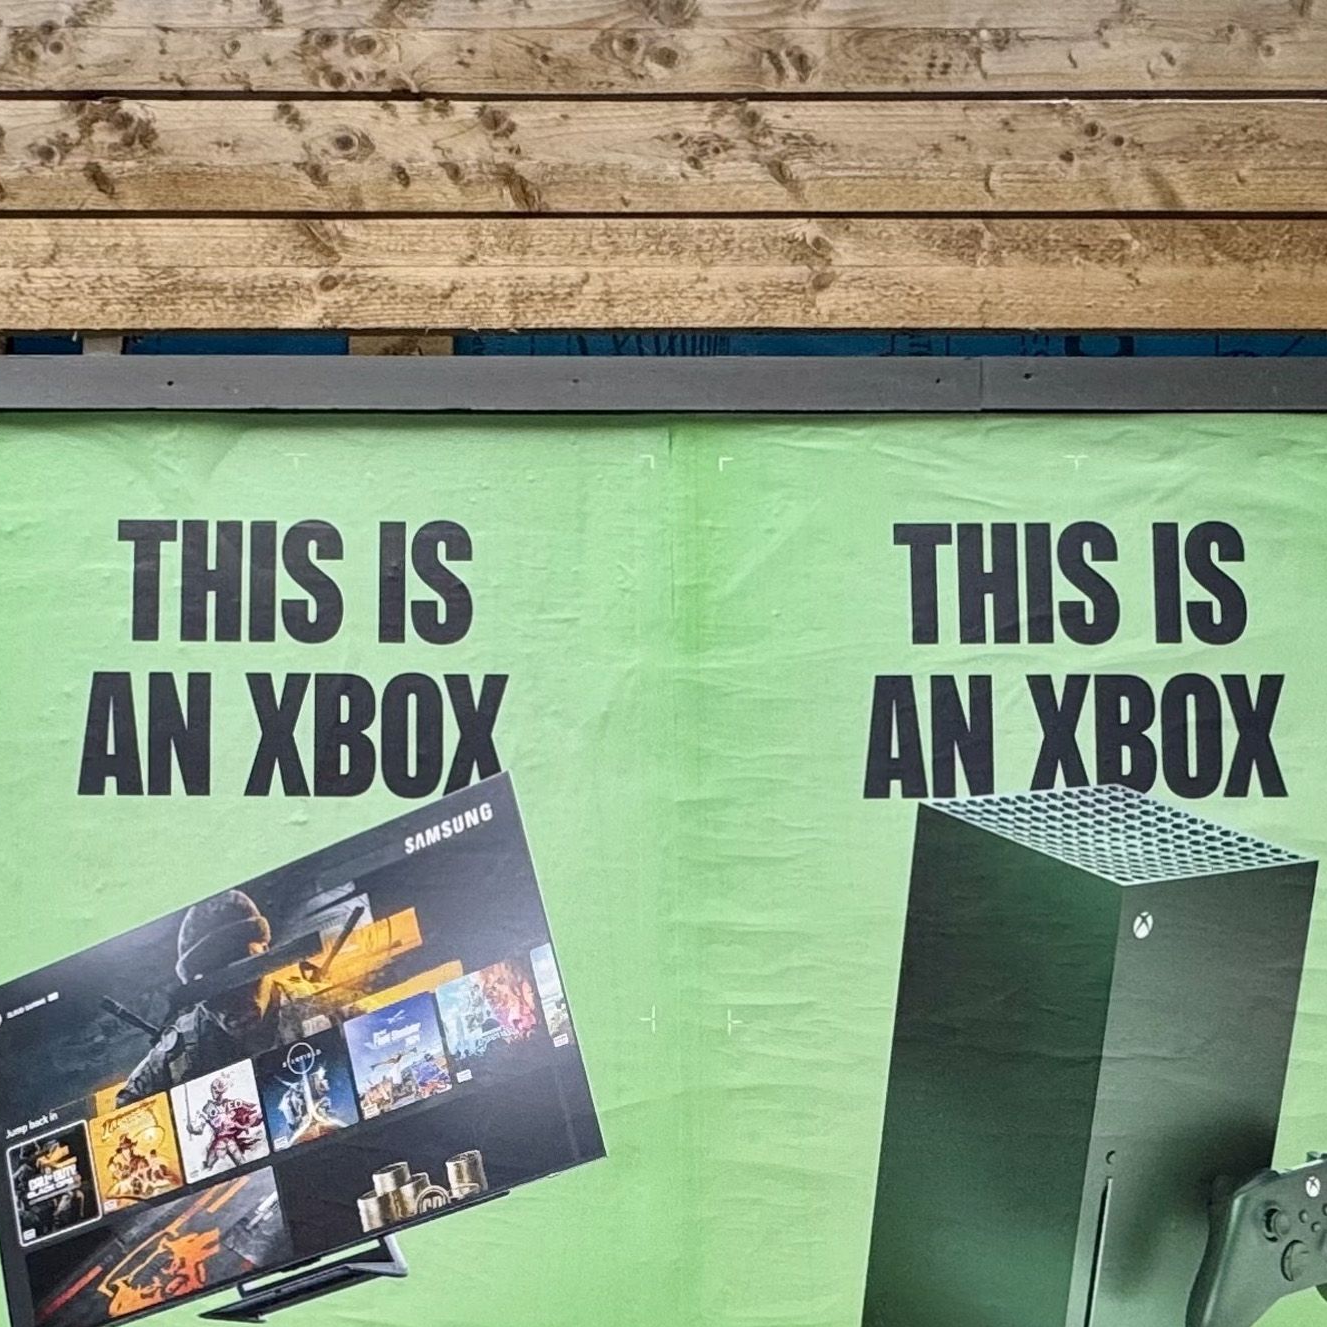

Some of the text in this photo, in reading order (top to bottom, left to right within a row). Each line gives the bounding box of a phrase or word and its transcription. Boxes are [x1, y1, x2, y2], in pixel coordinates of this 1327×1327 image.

[118, 519, 473, 645] THIS IS
[893, 520, 1248, 646] THIS IS
[77, 671, 509, 799] AN XBOX
[863, 672, 1288, 799] AN XBOX
[404, 802, 494, 854] SAMSUNG
